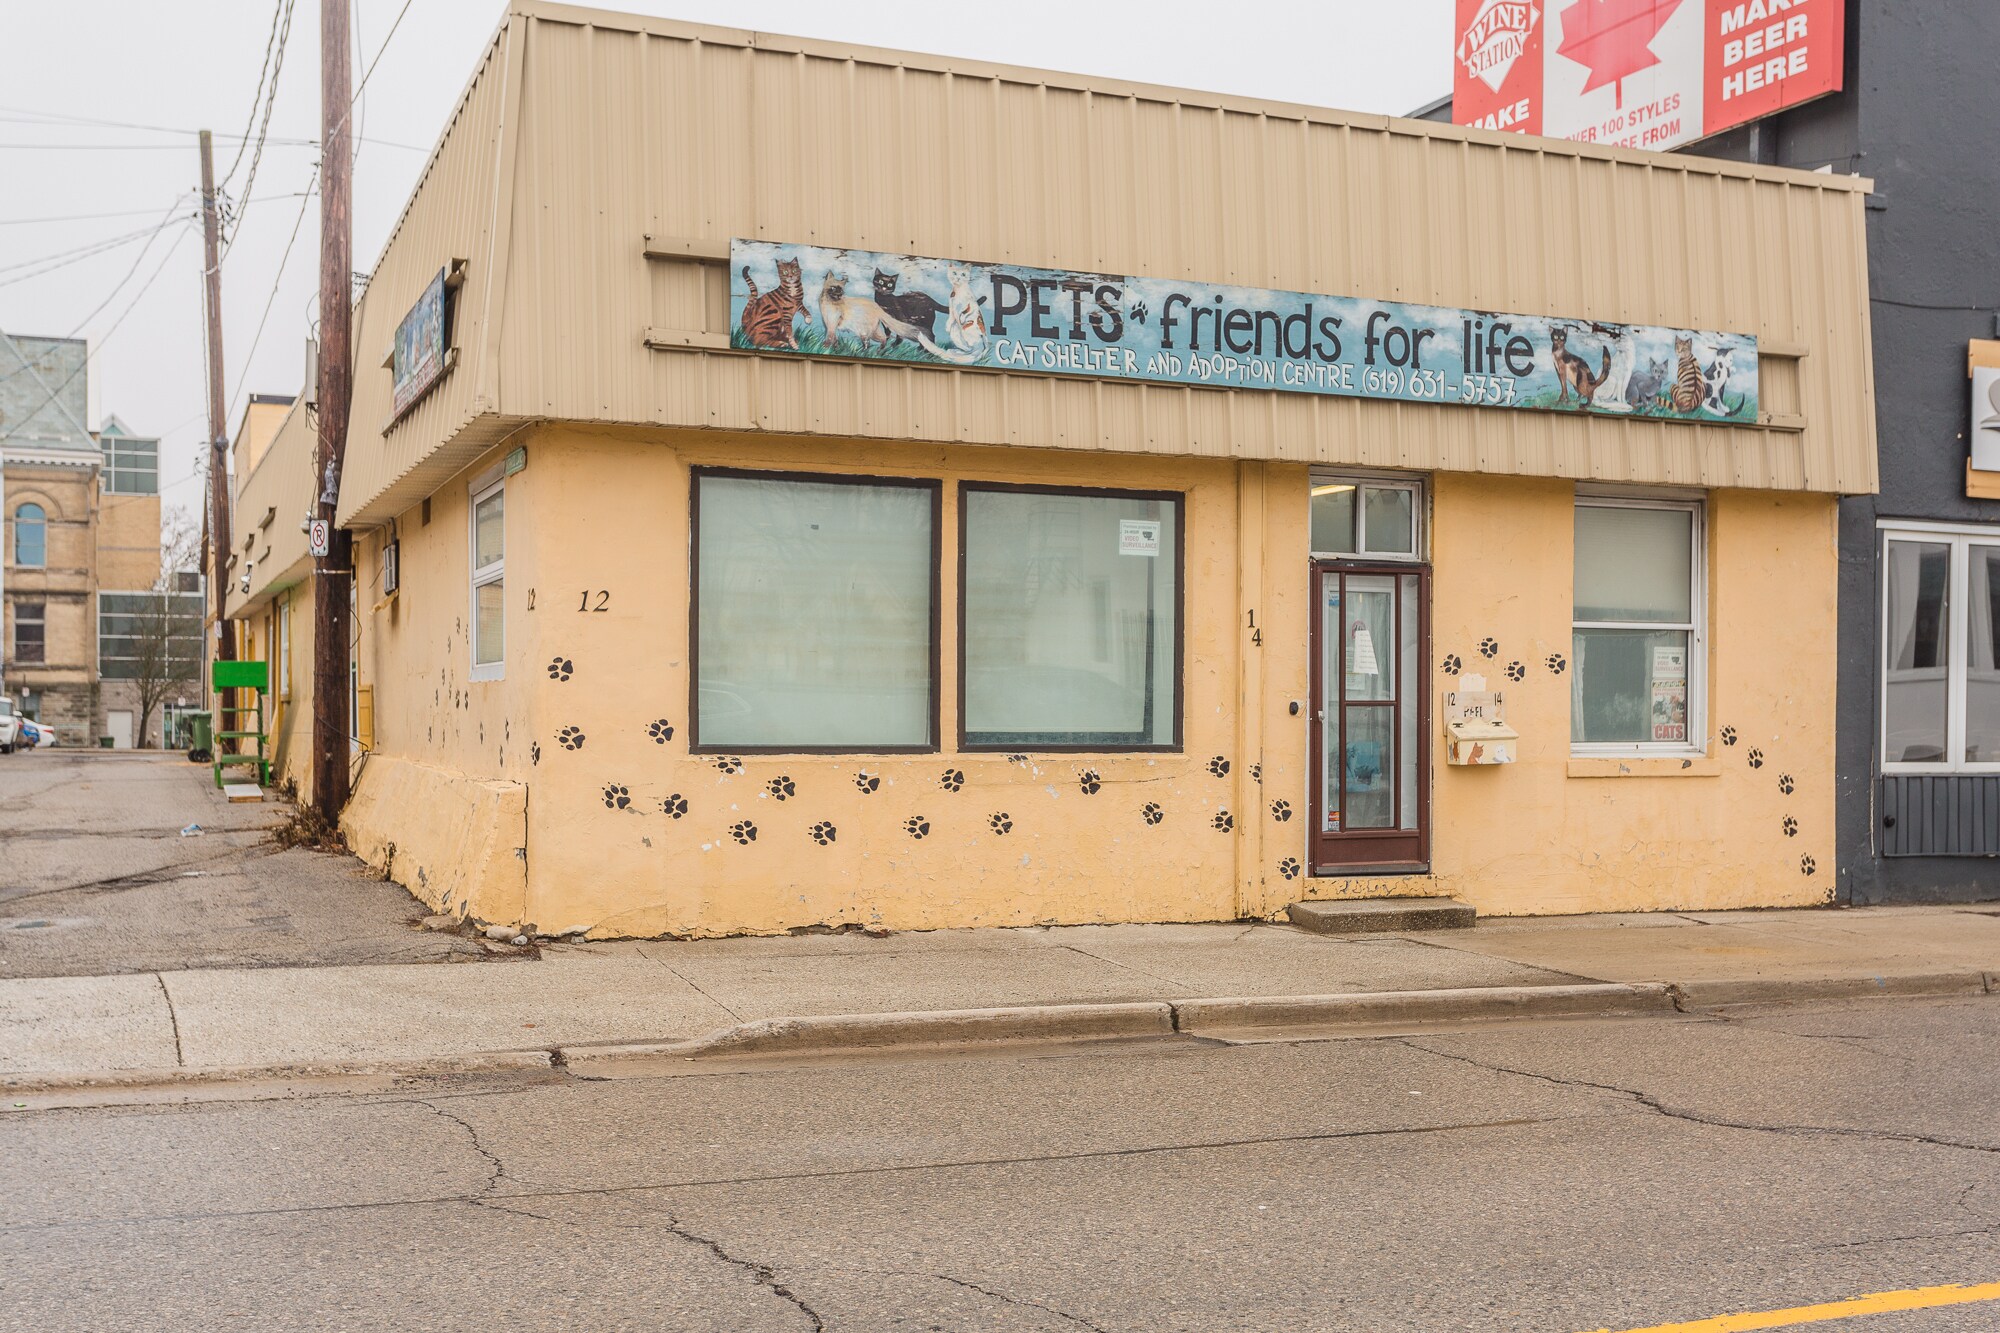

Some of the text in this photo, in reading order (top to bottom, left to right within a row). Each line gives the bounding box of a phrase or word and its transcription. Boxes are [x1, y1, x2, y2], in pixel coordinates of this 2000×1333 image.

[1467, 4, 1527, 52] WINE
[1721, 0, 1808, 36] MAK
[1471, 32, 1523, 76] STATION
[1724, 14, 1808, 68] BEER
[1723, 46, 1808, 101] HERE
[1565, 126, 1597, 142] VER
[1602, 116, 1624, 137] 100
[1628, 93, 1680, 127] STYLES
[1642, 118, 1680, 147] FROM
[990, 274, 1535, 377] PETS friends for life
[995, 339, 1040, 368] CAT
[1041, 340, 1140, 374] SHELTER
[1148, 351, 1183, 377] AND
[1282, 361, 1354, 390] CENTRE
[1362, 365, 1405, 394] (519)
[527, 588, 536, 611] 12
[577, 590, 610, 612] 12
[1447, 692, 1502, 706] 12 14
[1654, 724, 1683, 739] CATS
